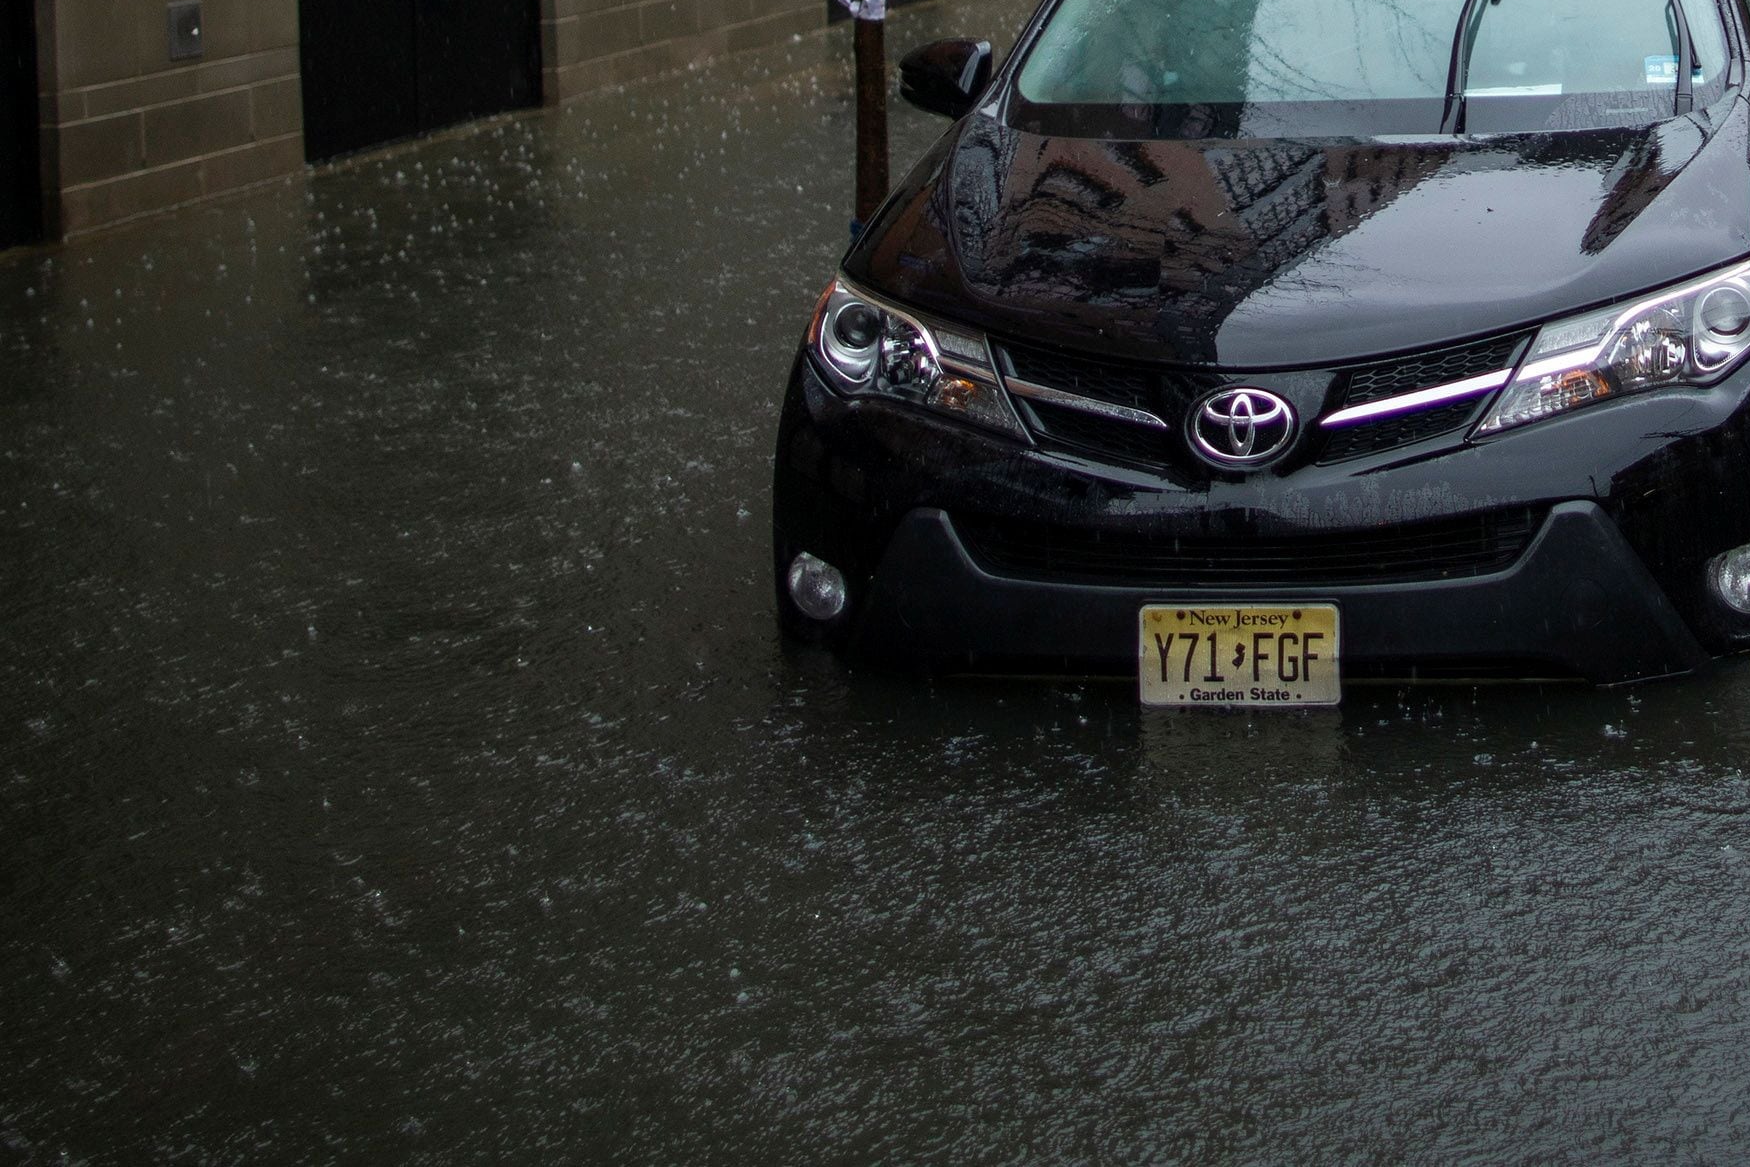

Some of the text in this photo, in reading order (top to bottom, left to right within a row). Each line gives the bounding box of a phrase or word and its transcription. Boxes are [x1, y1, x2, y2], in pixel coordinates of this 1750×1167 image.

[1189, 610, 1289, 628] New Jersey
[1189, 688, 1290, 701] Garden State
